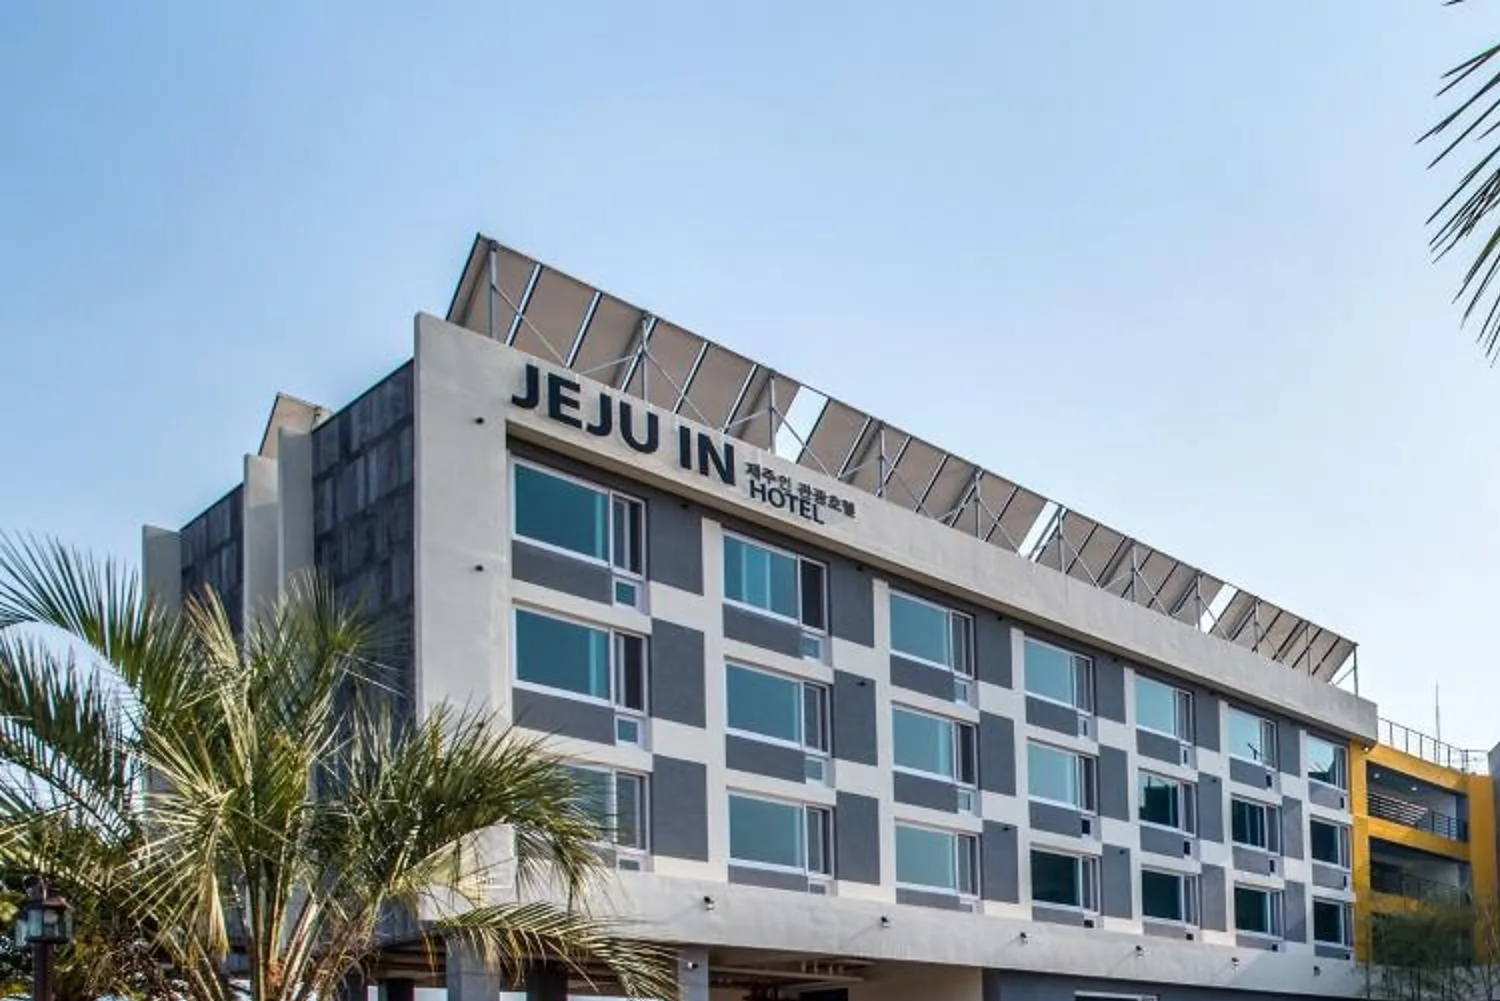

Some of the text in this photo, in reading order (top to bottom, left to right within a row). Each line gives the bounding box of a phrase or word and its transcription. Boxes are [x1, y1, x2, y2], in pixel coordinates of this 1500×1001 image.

[511, 363, 735, 485] JEJU IN
[749, 479, 825, 525] HOTEL
